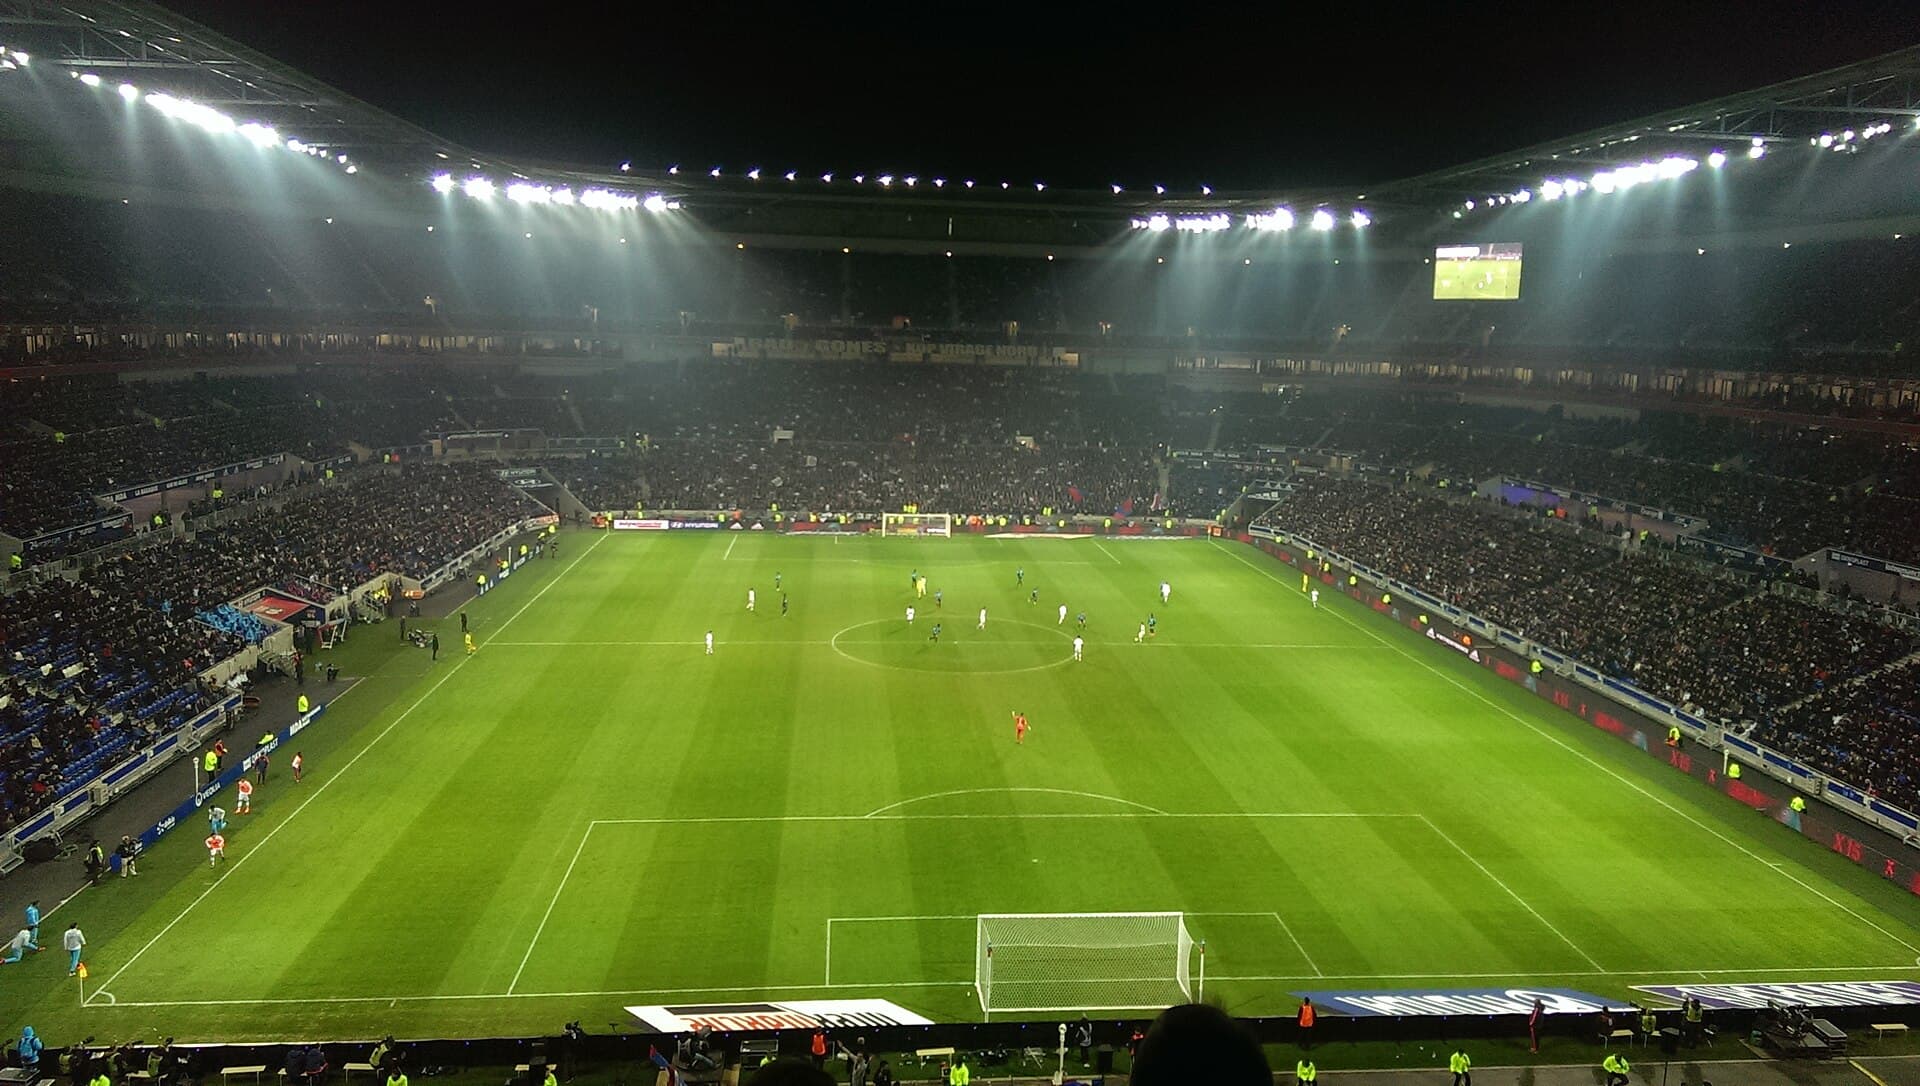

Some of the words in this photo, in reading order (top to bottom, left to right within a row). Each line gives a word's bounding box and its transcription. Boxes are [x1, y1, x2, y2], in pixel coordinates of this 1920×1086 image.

[815, 340, 887, 354] GONES
[941, 343, 993, 355] VIRAGE
[202, 783, 221, 800] VEOLIA
